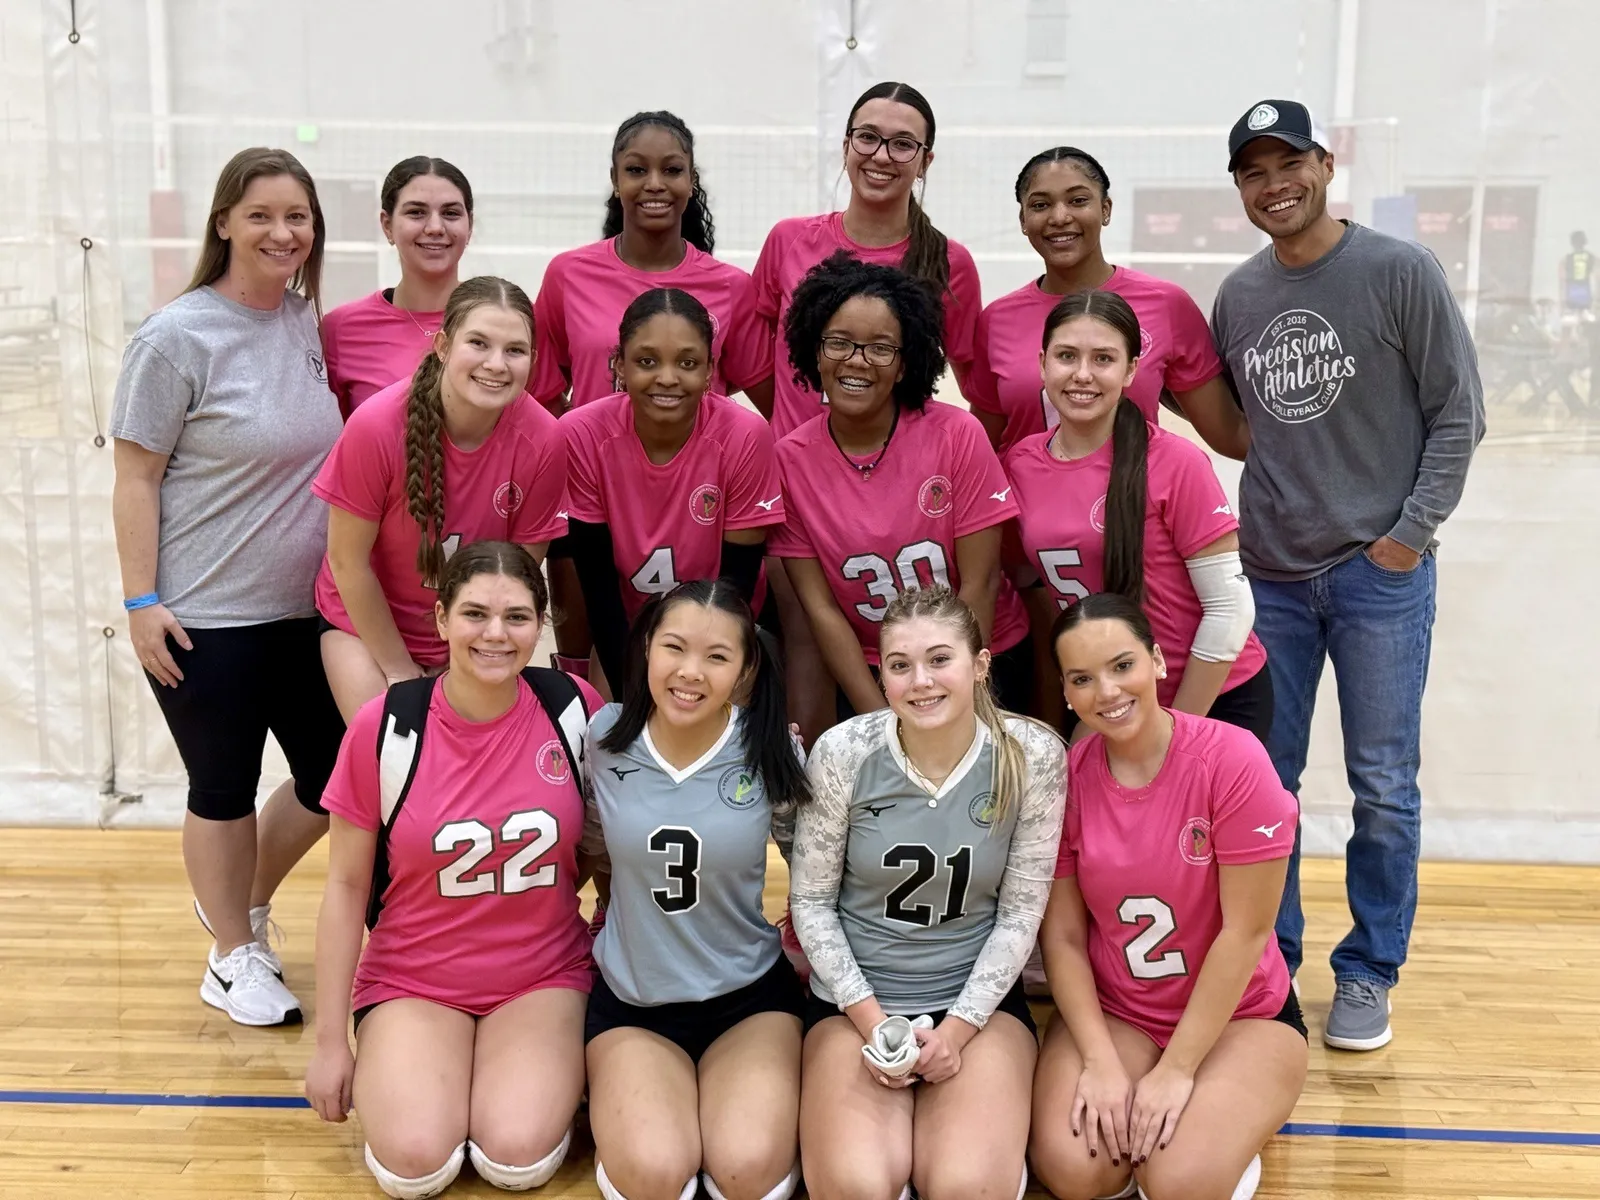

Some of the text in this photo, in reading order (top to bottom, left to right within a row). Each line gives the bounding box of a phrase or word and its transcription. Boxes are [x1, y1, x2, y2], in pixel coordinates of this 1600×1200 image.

[1243, 331, 1337, 381] Precision
[1271, 315, 1307, 337] EST. 2016
[1264, 354, 1356, 401] Athletics
[1272, 381, 1337, 417] VOLLEYBALL CLUB
[630, 544, 681, 595] 4
[842, 540, 951, 622] 30
[1037, 548, 1090, 611] 5
[433, 809, 558, 898] 22
[646, 825, 703, 915] 3
[882, 843, 972, 927] 21
[1117, 896, 1186, 980] 2
